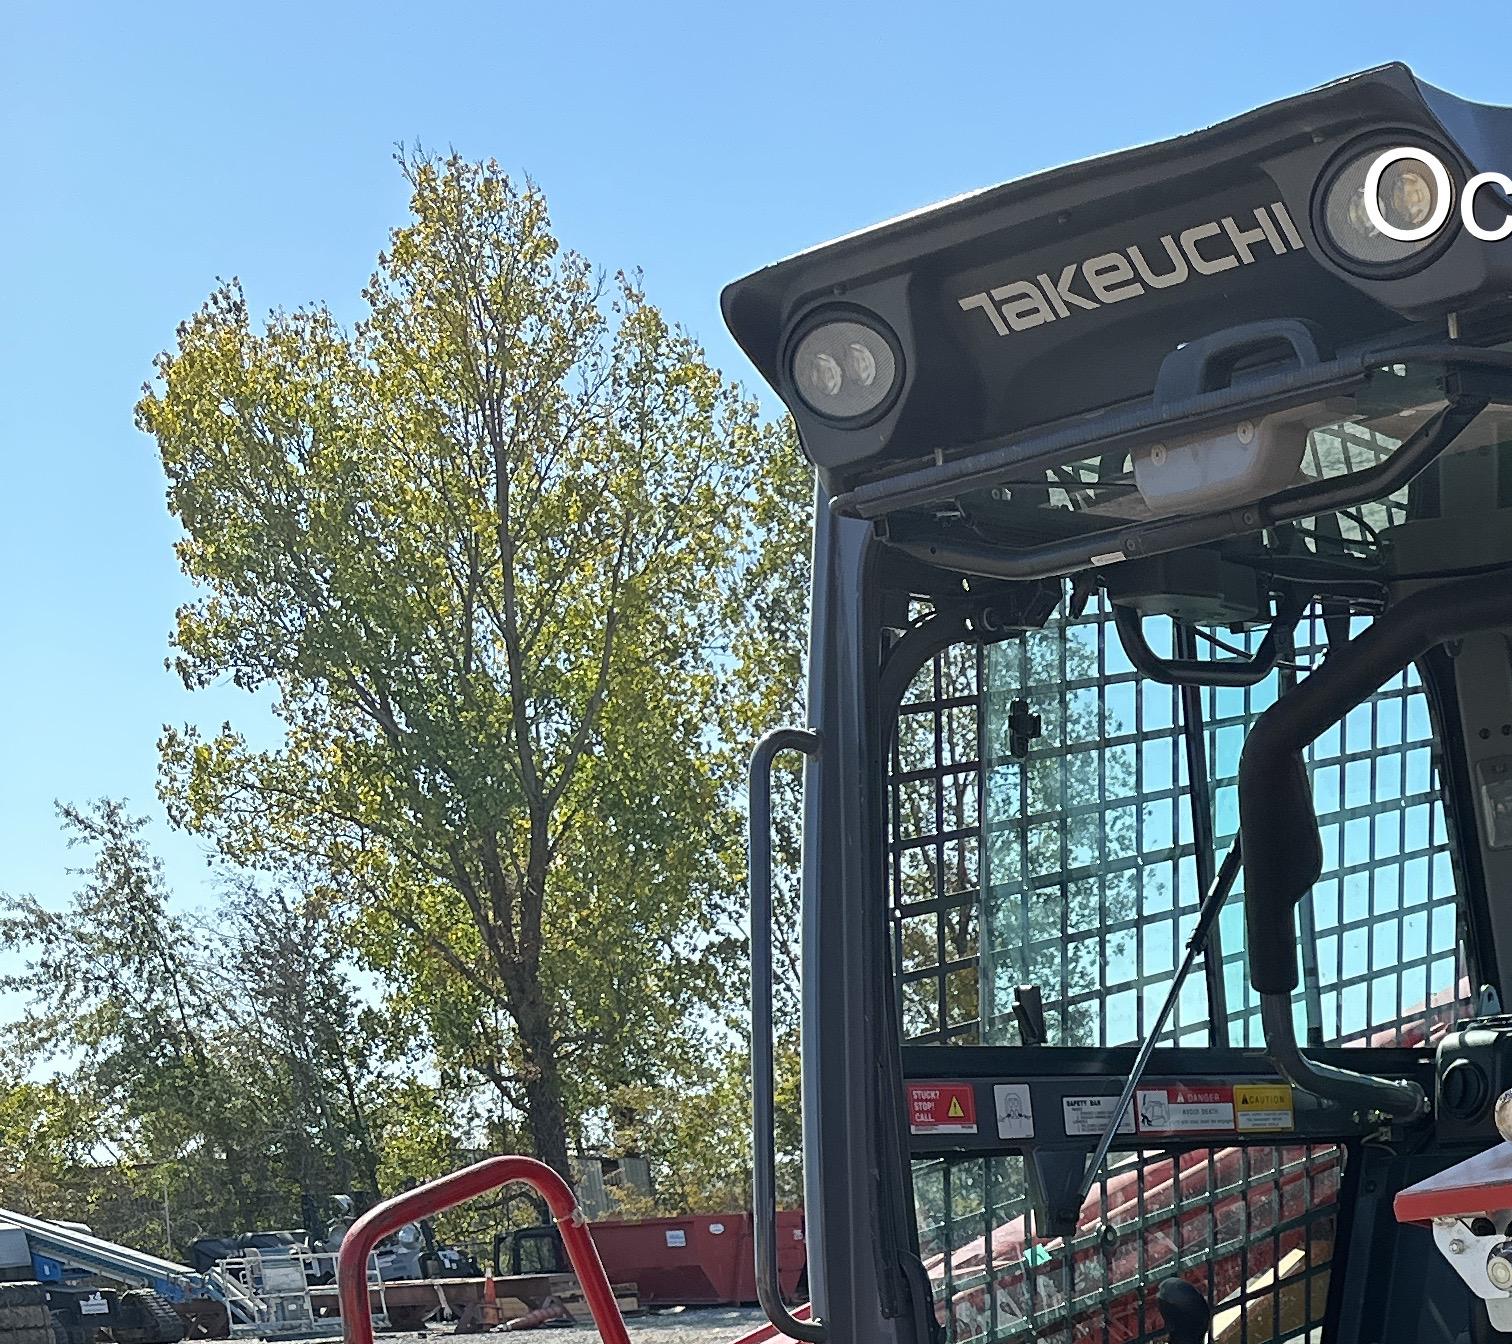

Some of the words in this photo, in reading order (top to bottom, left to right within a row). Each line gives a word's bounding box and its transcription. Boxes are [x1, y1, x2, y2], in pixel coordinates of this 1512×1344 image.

[958, 201, 1306, 338] TAKEUCHI
[912, 1090, 940, 1100] STUCK?
[1187, 1093, 1220, 1103] DANGER
[1066, 1099, 1087, 1107] SAFETY
[1249, 1096, 1285, 1105] CAUTION
[914, 1101, 935, 1111] STOP!
